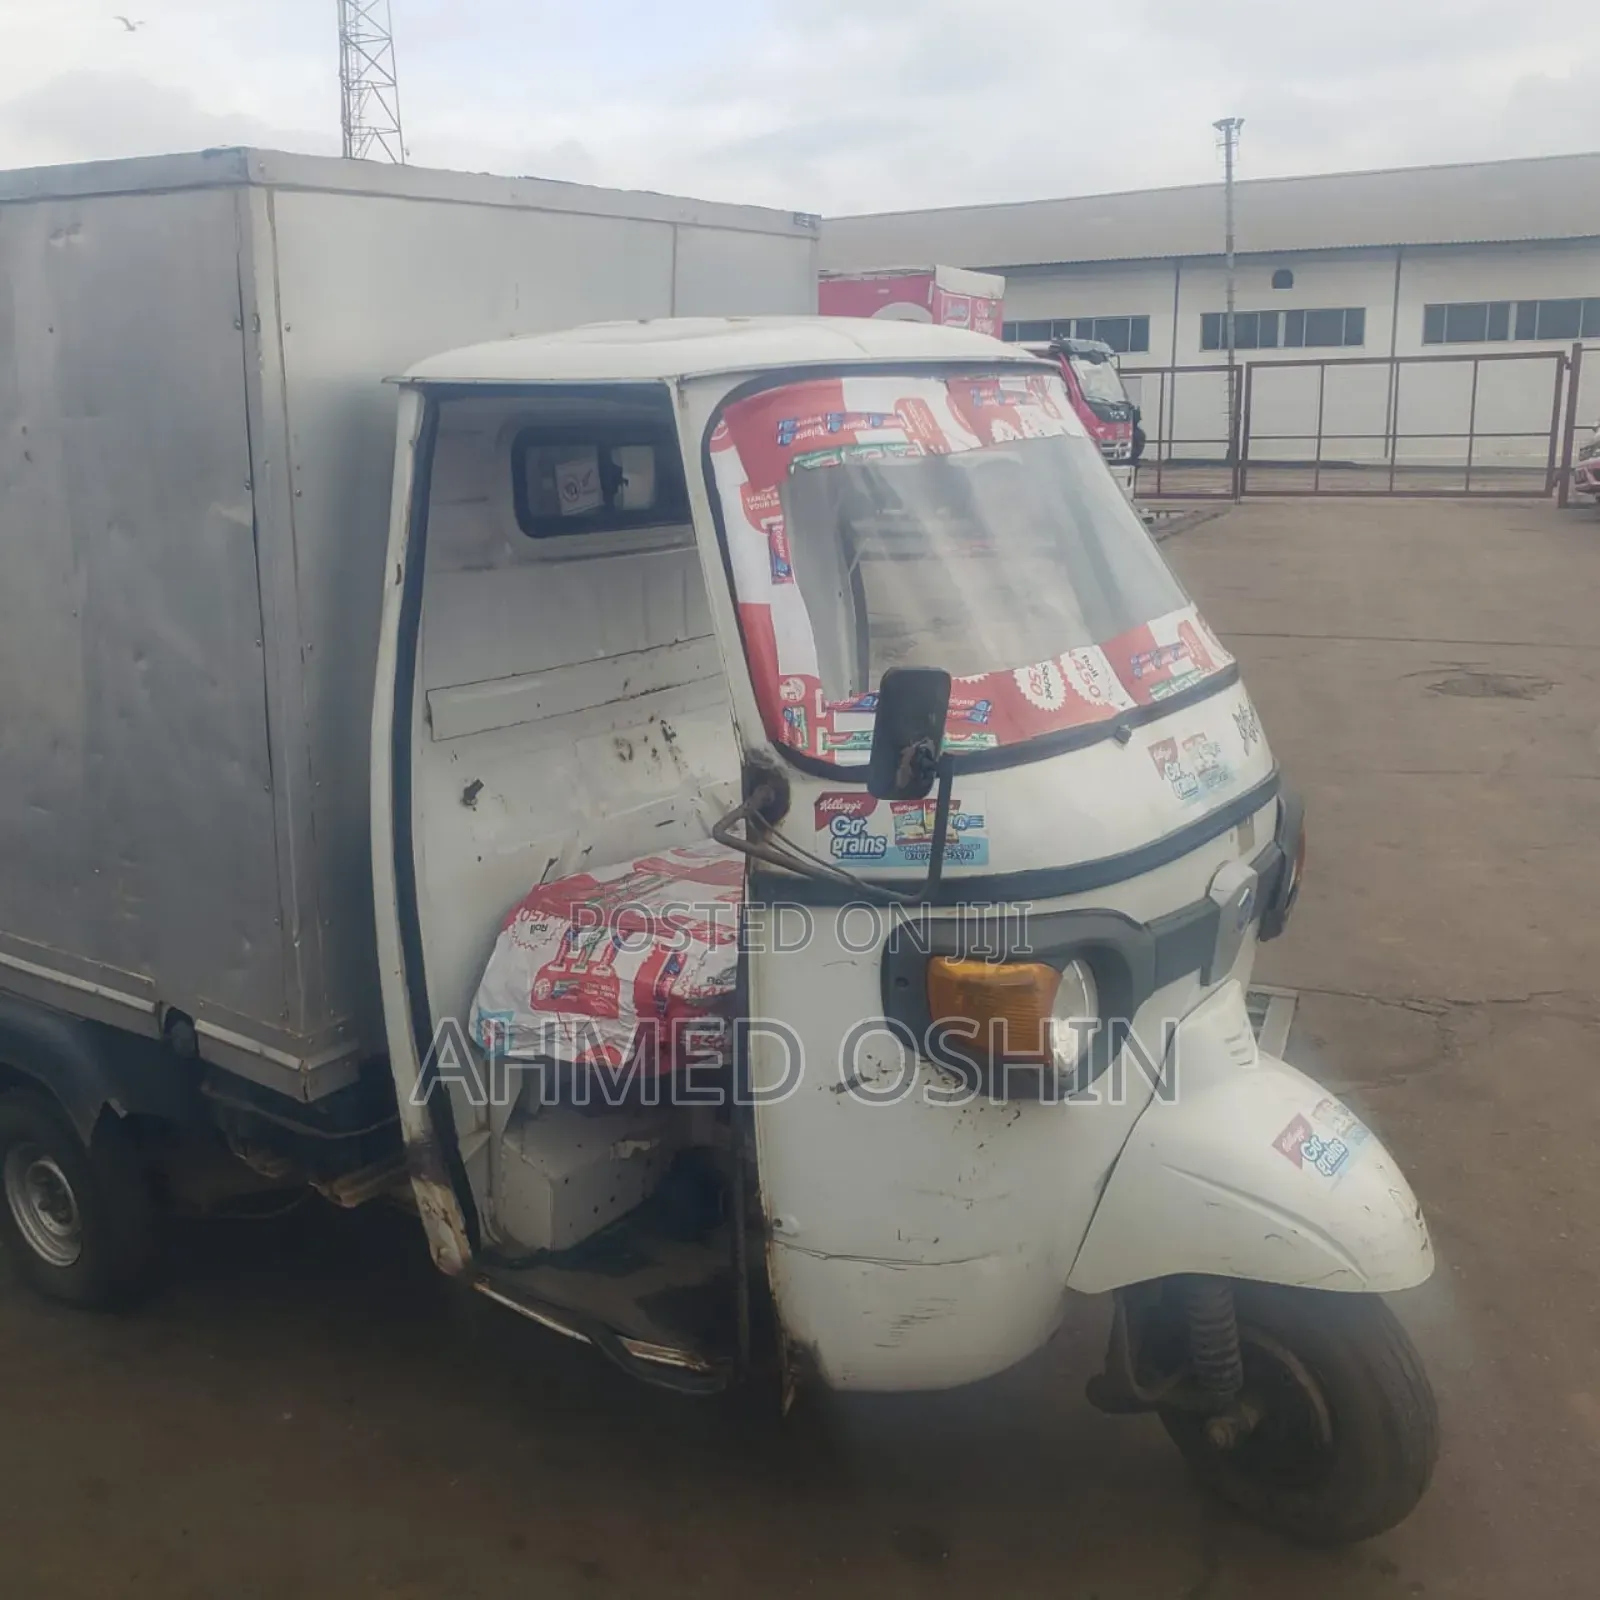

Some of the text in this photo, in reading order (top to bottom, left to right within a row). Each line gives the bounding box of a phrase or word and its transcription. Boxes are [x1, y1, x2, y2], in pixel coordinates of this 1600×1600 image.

[819, 797, 864, 814] Kellogg's
[830, 814, 868, 837] Go
[831, 835, 888, 859] grains
[530, 923, 549, 934] Roll
